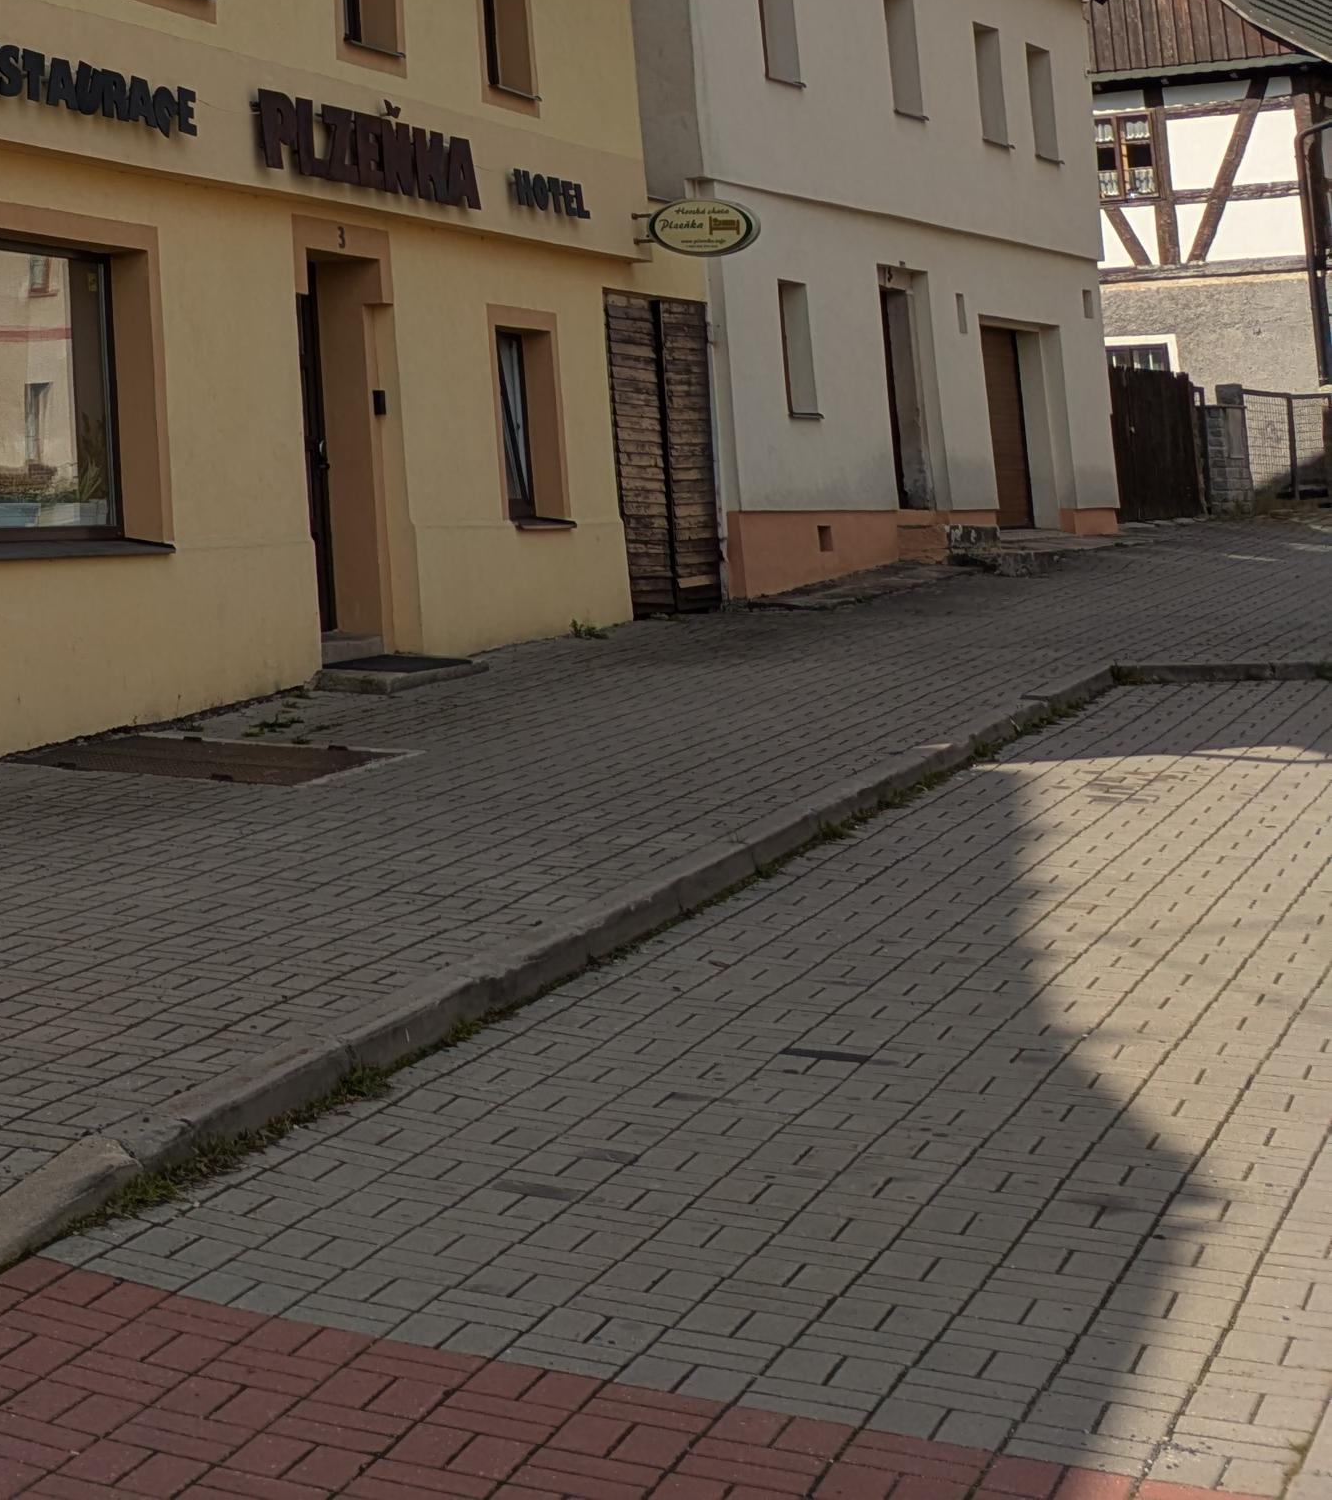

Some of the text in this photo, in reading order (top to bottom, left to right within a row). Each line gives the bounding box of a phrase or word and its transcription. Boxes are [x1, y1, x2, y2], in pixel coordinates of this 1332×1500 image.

[257, 88, 482, 211] PLZEŇKA
[513, 168, 591, 219] HOTEL
[337, 226, 346, 249] 3
